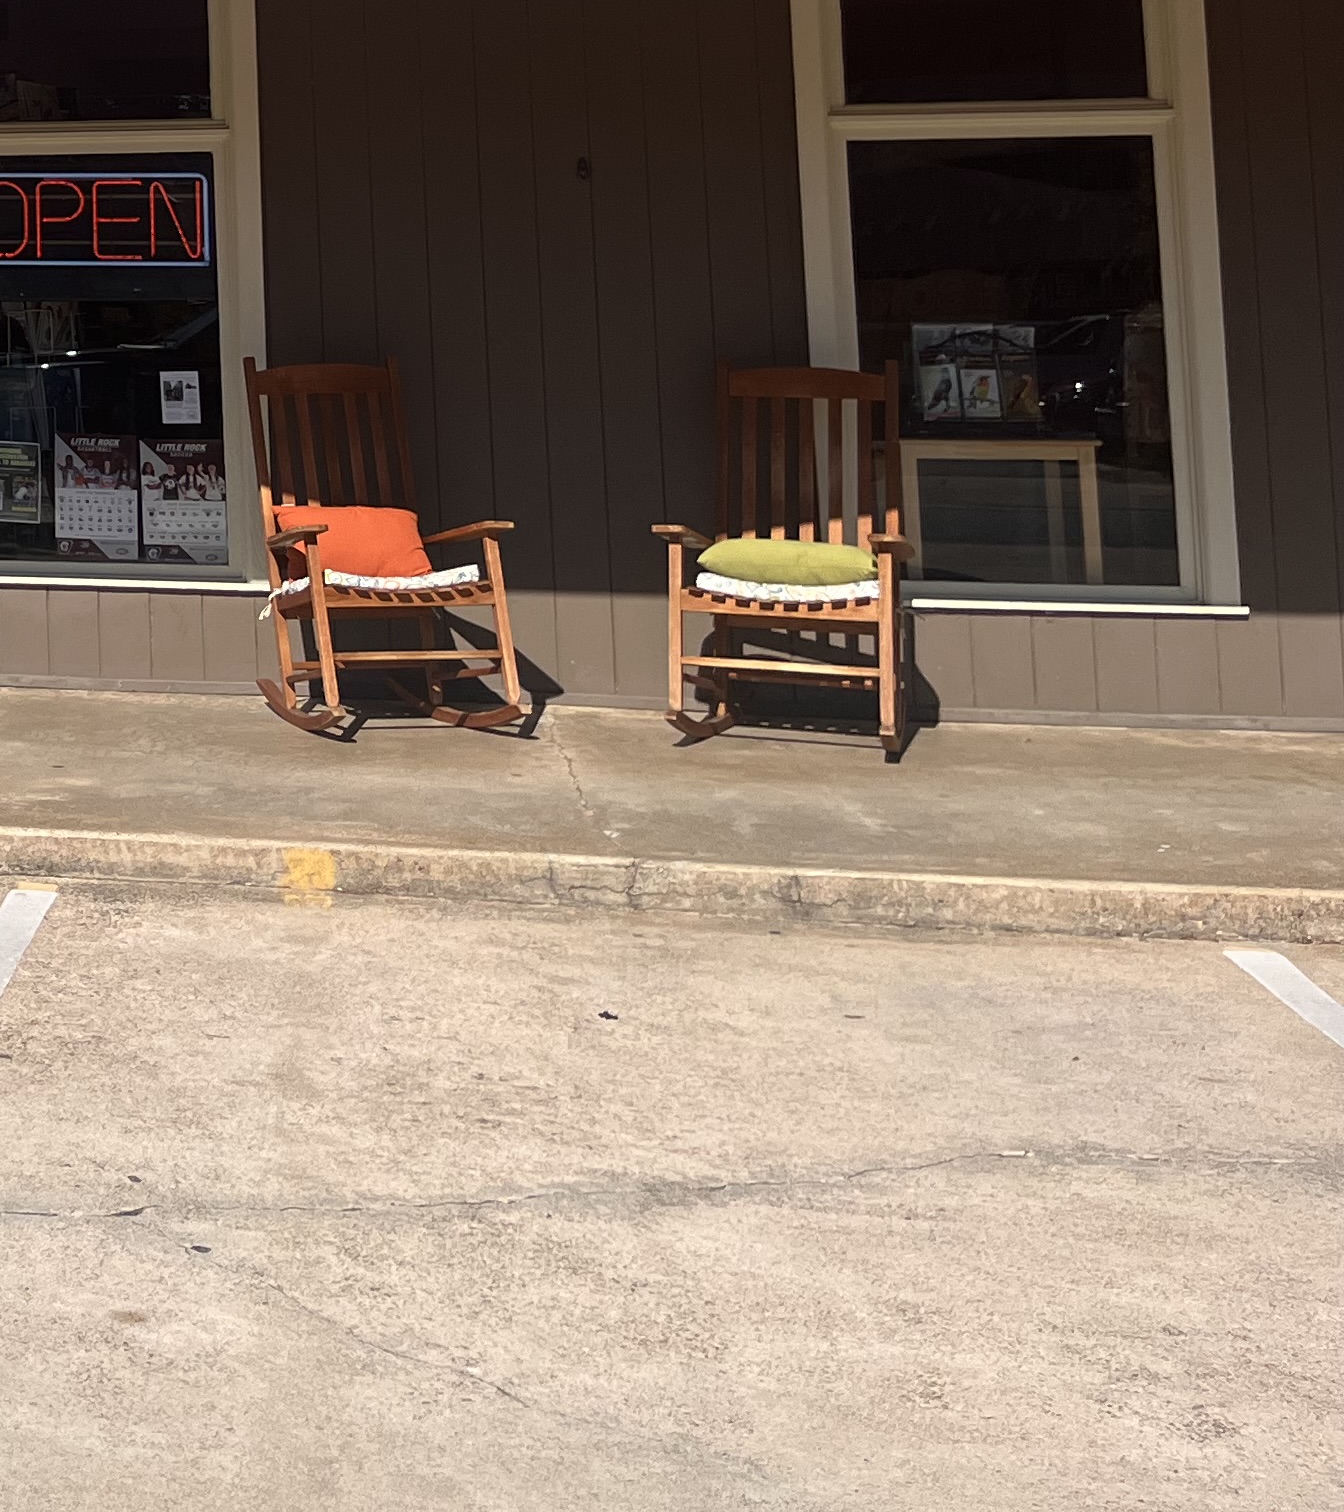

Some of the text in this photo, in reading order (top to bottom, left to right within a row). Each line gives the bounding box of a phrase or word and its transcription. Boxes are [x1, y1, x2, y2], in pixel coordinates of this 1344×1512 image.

[70, 437, 121, 448] LITTLE ROCK
[156, 443, 208, 452] LITTLE ROCK
